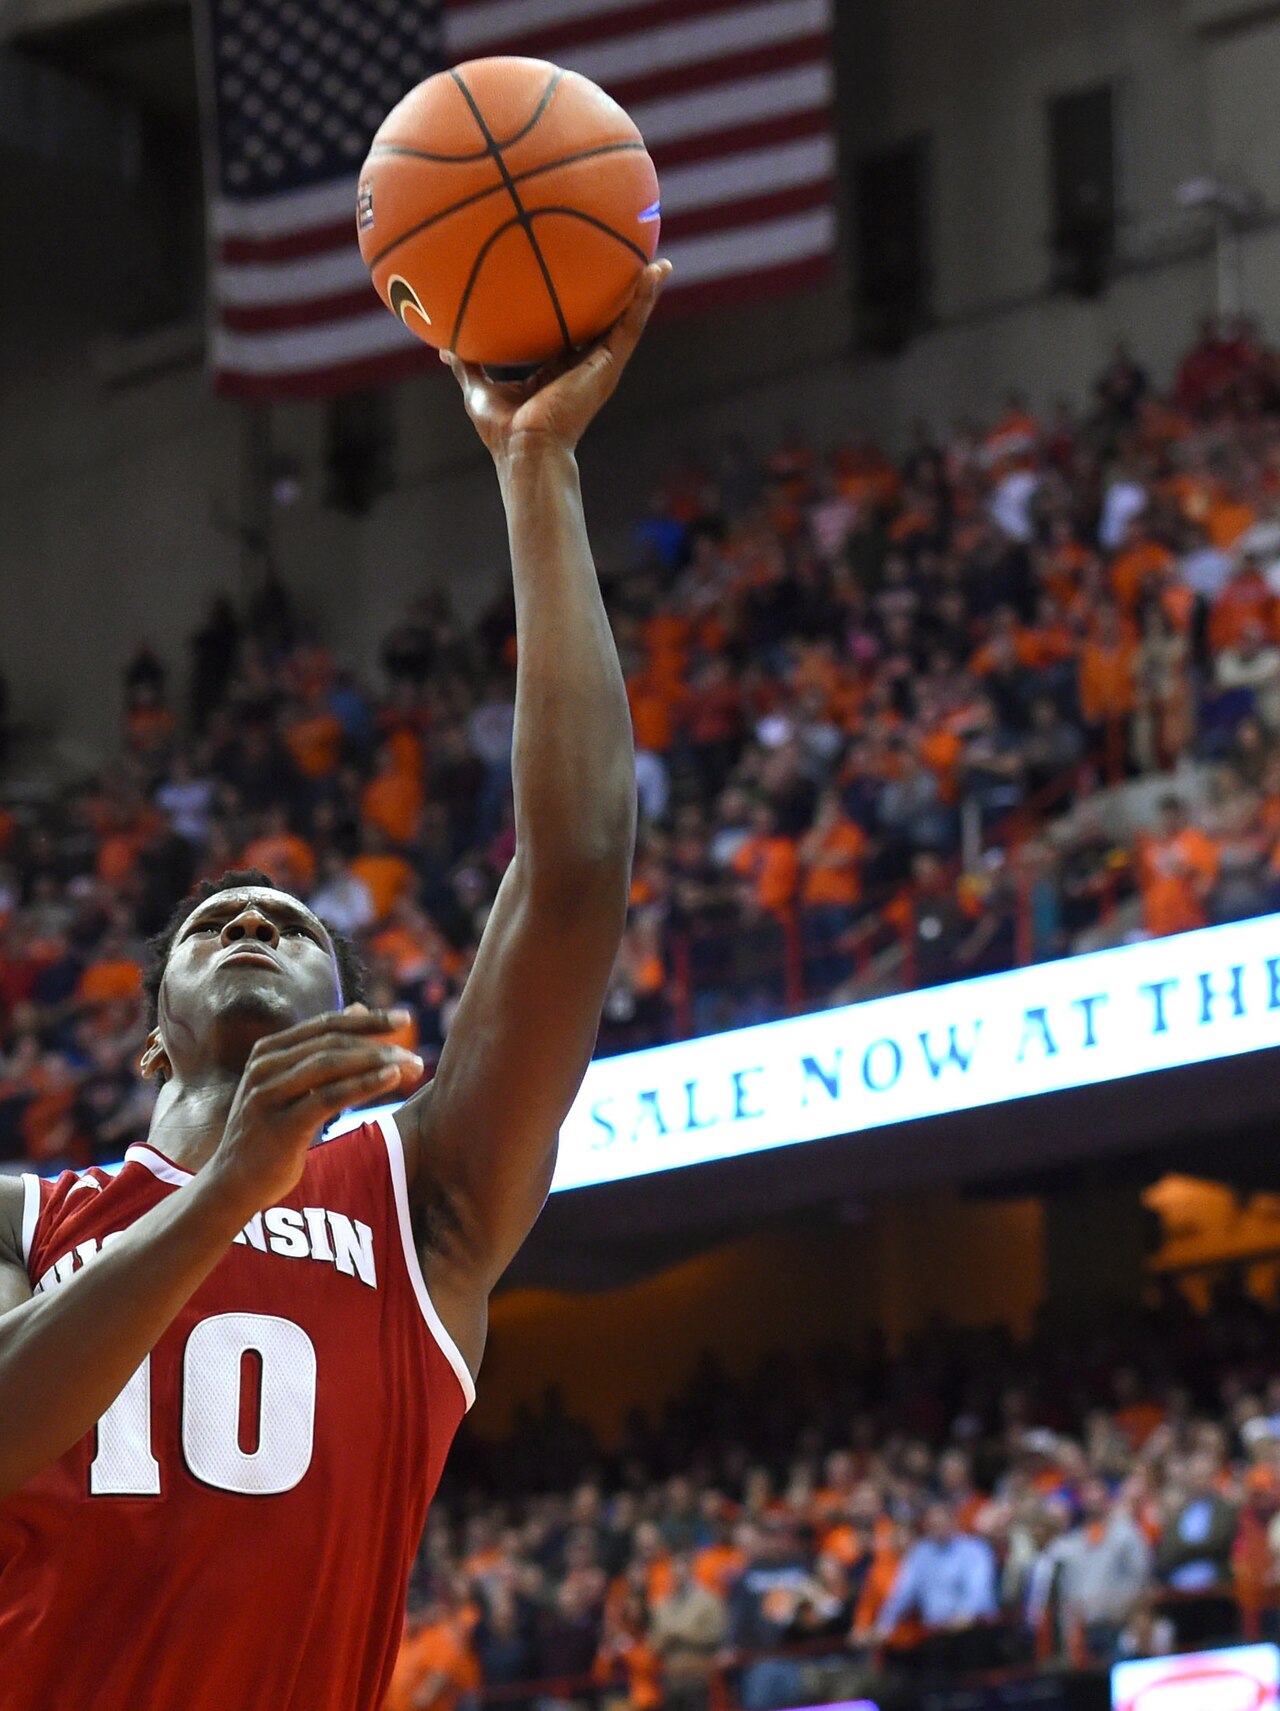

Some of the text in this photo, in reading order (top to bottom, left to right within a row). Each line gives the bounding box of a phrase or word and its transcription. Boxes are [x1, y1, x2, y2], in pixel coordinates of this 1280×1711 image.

[590, 1065, 766, 1151] SALE
[800, 1017, 984, 1108] NOW
[1016, 991, 1110, 1064] AT
[90, 1312, 317, 1495] 10
